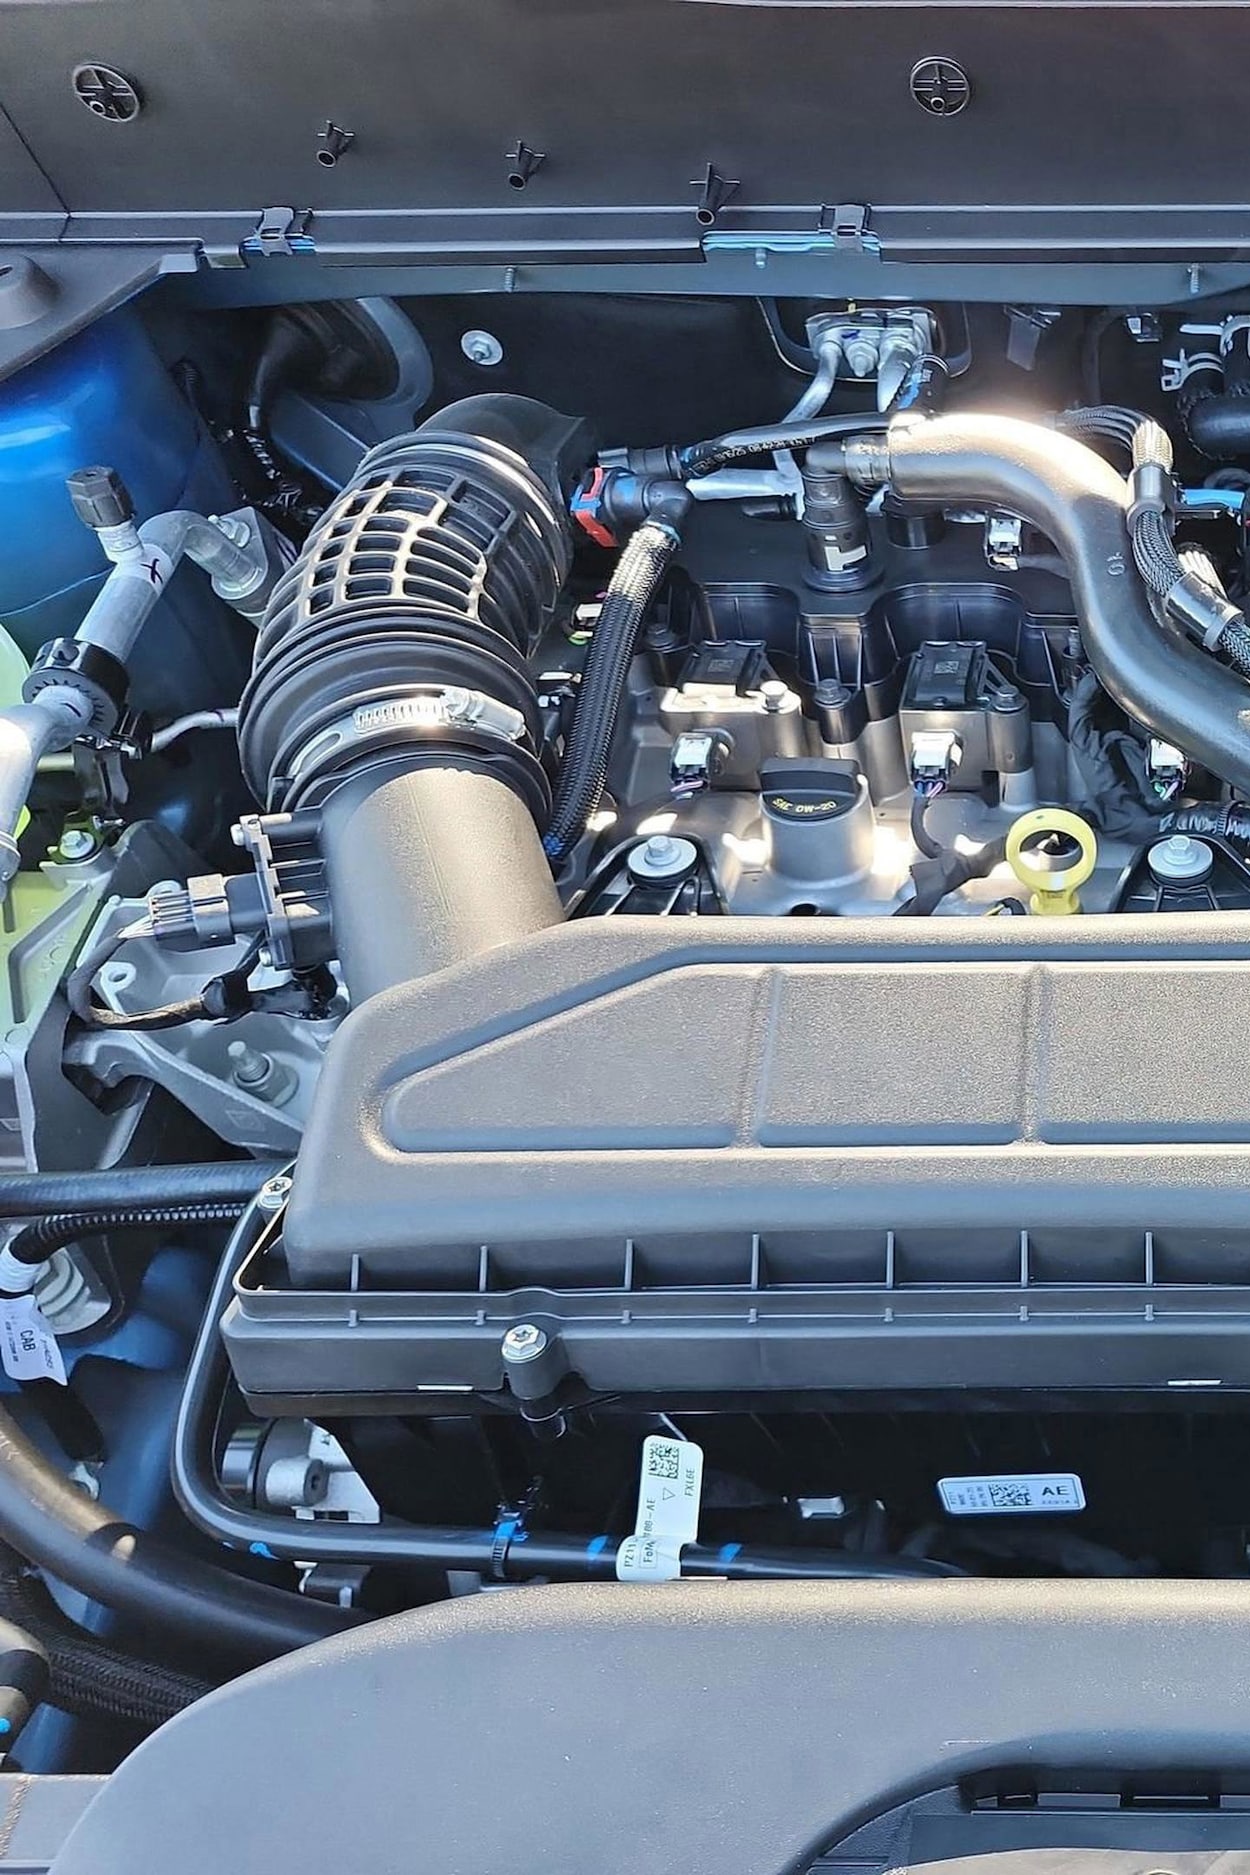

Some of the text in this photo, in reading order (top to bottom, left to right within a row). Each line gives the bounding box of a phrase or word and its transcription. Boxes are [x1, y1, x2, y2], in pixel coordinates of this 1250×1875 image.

[772, 797, 837, 814] SAE 0W-20
[20, 1330, 36, 1351] CAB
[1041, 1485, 1070, 1497] AE
